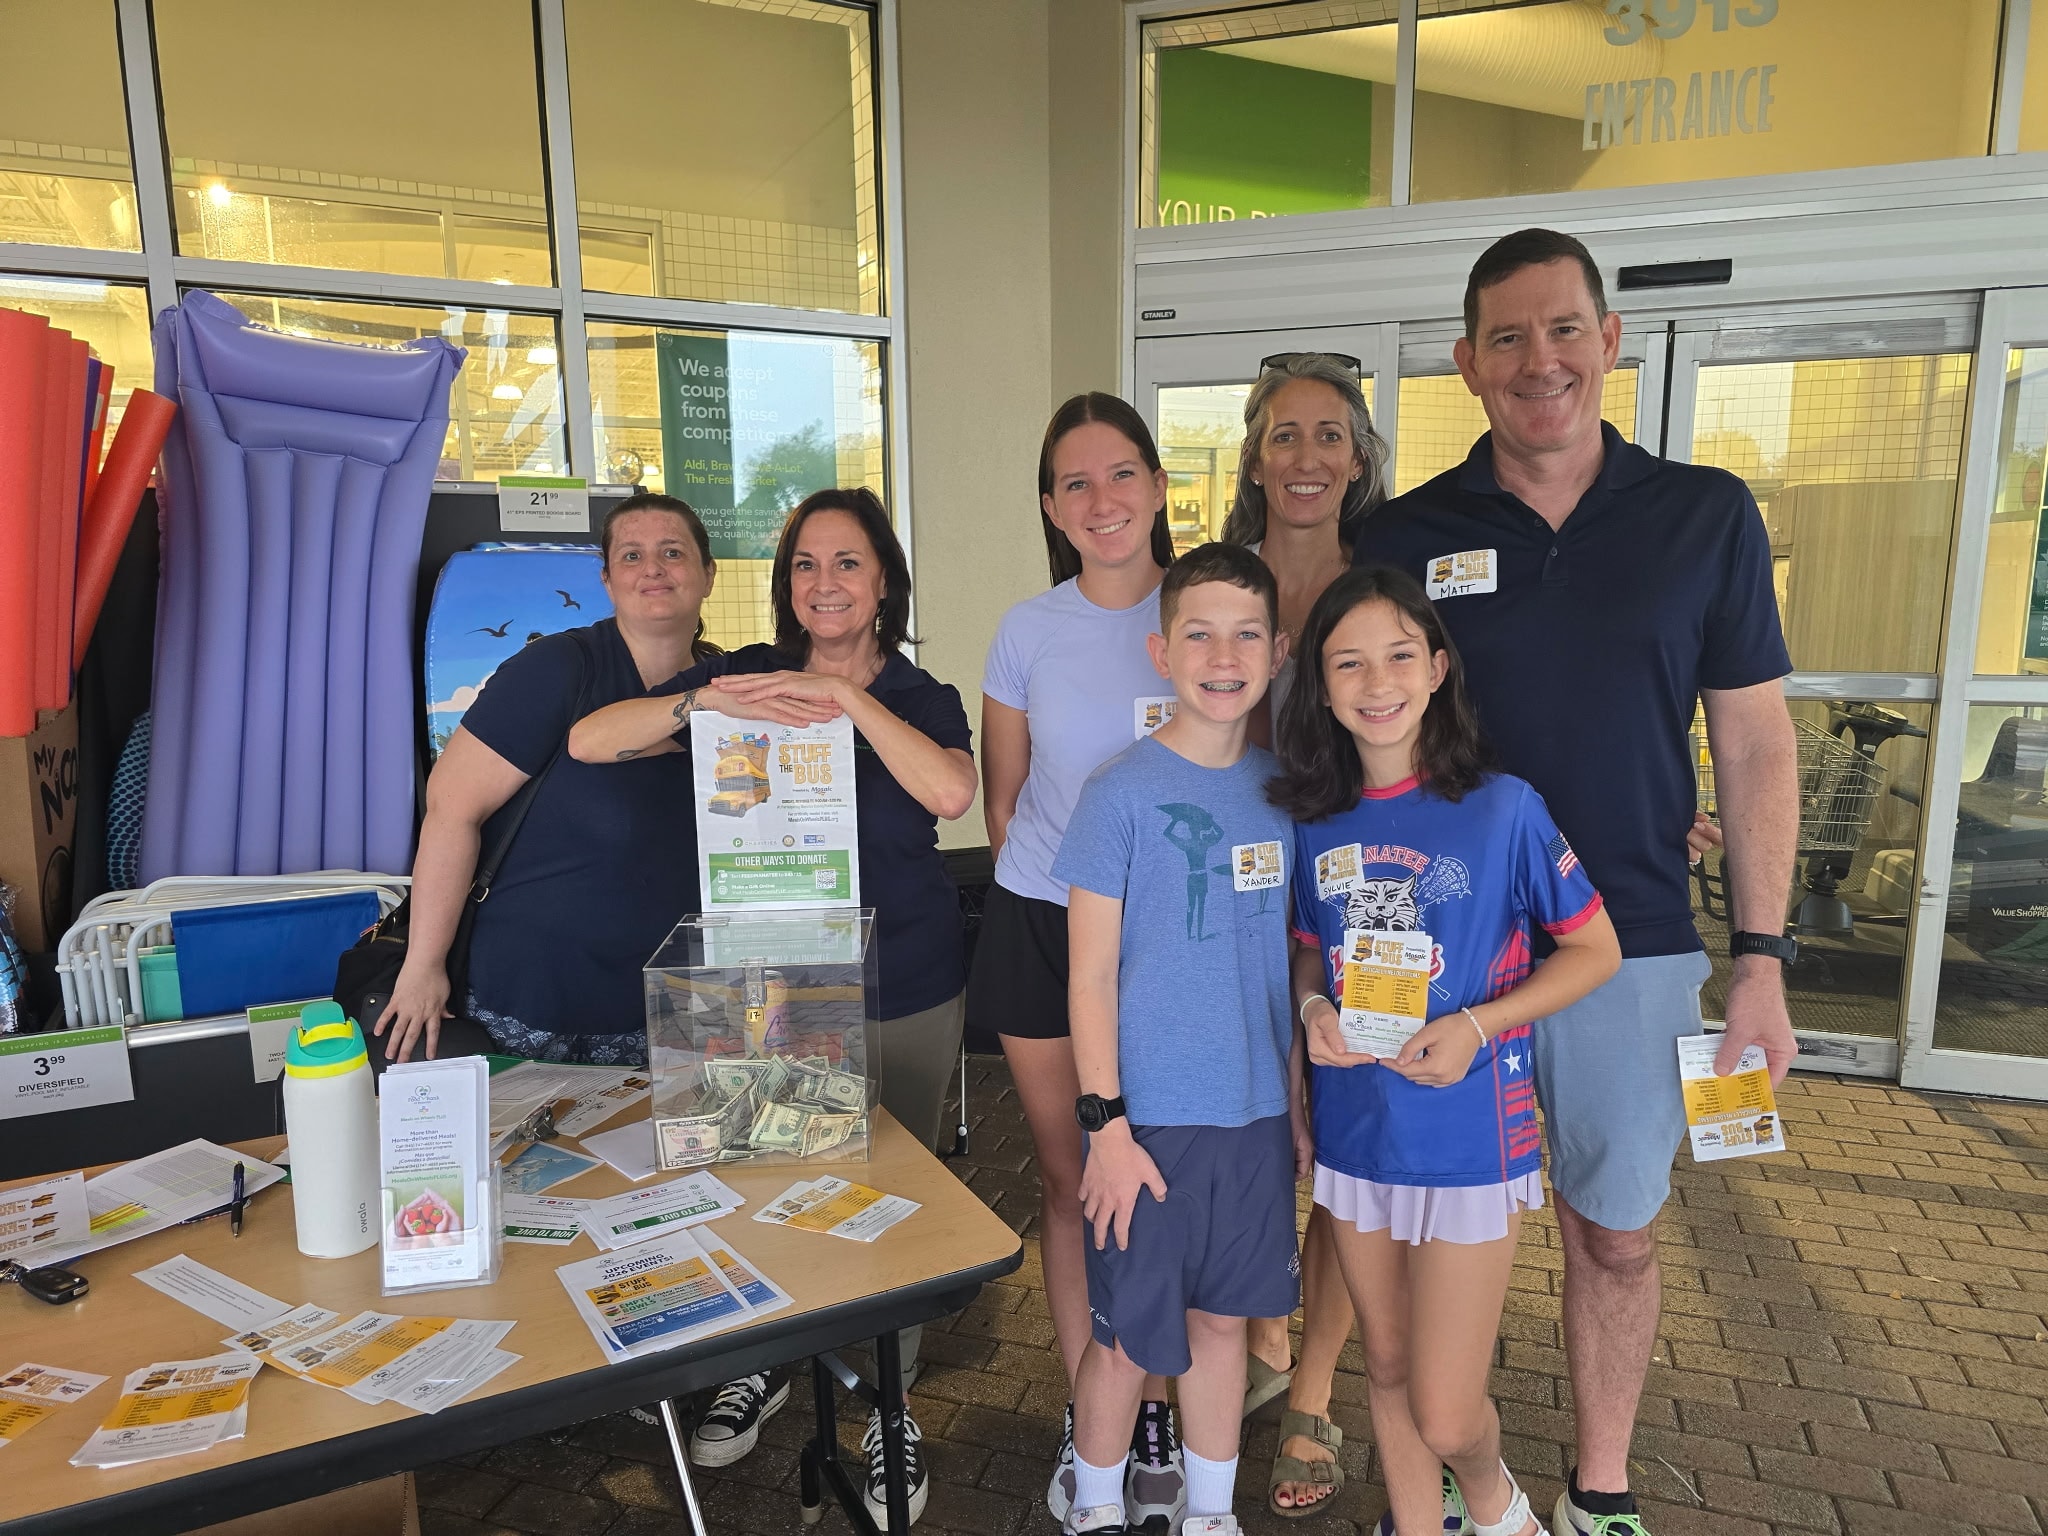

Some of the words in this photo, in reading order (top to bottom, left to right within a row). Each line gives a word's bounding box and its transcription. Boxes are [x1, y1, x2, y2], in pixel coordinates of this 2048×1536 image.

[1582, 64, 1777, 151] ENTRANCE
[1144, 310, 1174, 319] STANLEY
[679, 358, 709, 376] We
[714, 366, 775, 385] accept
[680, 384, 757, 403] coupons
[682, 401, 726, 419] from
[733, 404, 778, 422] these
[683, 425, 792, 444] competitors
[684, 460, 708, 471] Aldi,
[711, 460, 740, 471] Brav
[745, 463, 804, 474] ve-A-Lot,
[685, 473, 705, 484] The
[742, 476, 777, 486] arket
[530, 492, 548, 505] 21
[701, 508, 717, 517] you
[720, 507, 736, 518] get
[738, 507, 752, 516] the
[701, 518, 721, 527] hout
[725, 519, 751, 529] giving
[755, 521, 765, 529] up
[724, 530, 756, 540] quality,
[1457, 551, 1488, 564] STUFF
[1465, 561, 1488, 573] BUS
[1441, 583, 1476, 598] MATT
[34, 744, 56, 776] MY
[779, 744, 831, 764] STUFF
[779, 765, 793, 773] THE
[794, 764, 832, 784] BUS
[1257, 843, 1278, 855] STUFF
[1331, 846, 1355, 862] STUFF
[735, 856, 760, 866] OTHER
[762, 856, 784, 866] WAYS
[785, 855, 795, 865] TO
[798, 854, 827, 864] DONATE
[1264, 854, 1279, 866] BUS
[1336, 858, 1355, 872] BUS
[1362, 844, 1430, 874] NATEE
[1242, 875, 1280, 887] XANDER
[1324, 879, 1353, 896] SYLVIE
[1374, 940, 1404, 953] STUFF
[1381, 952, 1402, 965] BUS
[1405, 952, 1426, 960] Mosaic
[34, 1057, 50, 1075] 3
[50, 1056, 65, 1064] 99
[19, 1077, 84, 1092] DIVERSIFIED
[1721, 1122, 1744, 1135] BUS
[392, 1135, 437, 1143] Home-delivered
[1723, 1131, 1754, 1147] STUFF
[682, 1208, 695, 1216] TO
[695, 1202, 717, 1212] HOW
[358, 1202, 368, 1233] owala
[656, 1212, 680, 1222] GIVE
[602, 1270, 628, 1280] 2026
[630, 1256, 674, 1271] EVENTS!
[605, 1254, 664, 1274] UPCOMING
[619, 1276, 647, 1289] STUFF
[633, 1282, 652, 1290] BUS
[620, 1296, 651, 1308] EMPTY
[623, 1300, 656, 1312] BOWLS
[219, 1367, 251, 1375] Mosaic
[1210, 1517, 1222, 1526] nike
